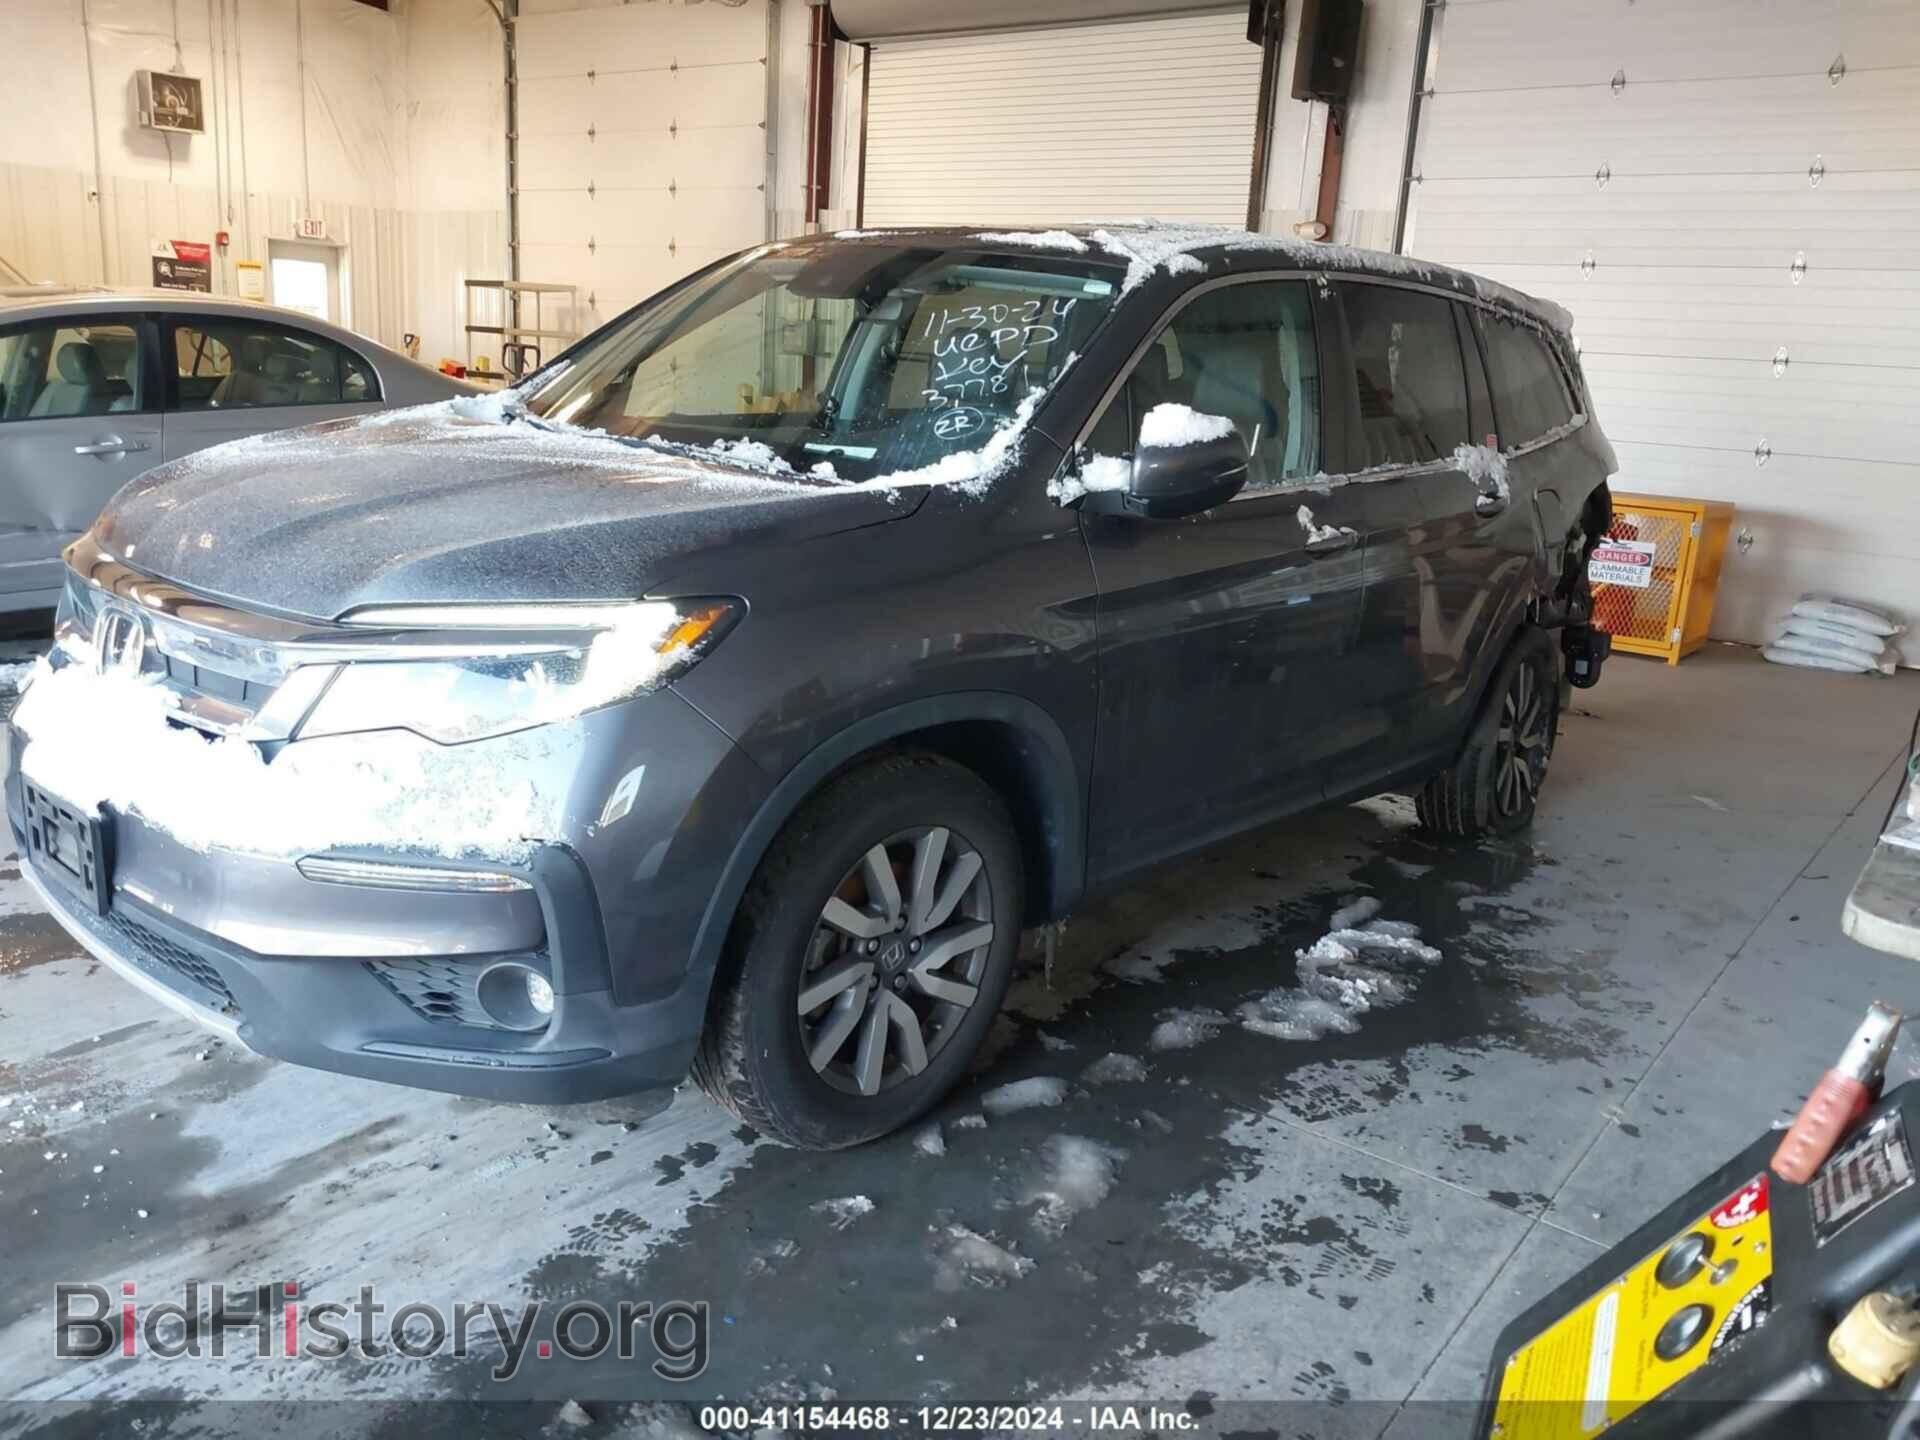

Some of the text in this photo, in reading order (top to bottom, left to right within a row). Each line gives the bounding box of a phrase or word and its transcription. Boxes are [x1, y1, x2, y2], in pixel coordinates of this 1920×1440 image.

[304, 219, 323, 236] EXIT
[923, 298, 1078, 337] 11-30-24
[1599, 550, 1642, 562] DANGER
[1589, 562, 1648, 576] FLAMMABLE
[1590, 570, 1642, 584] MATERIALS
